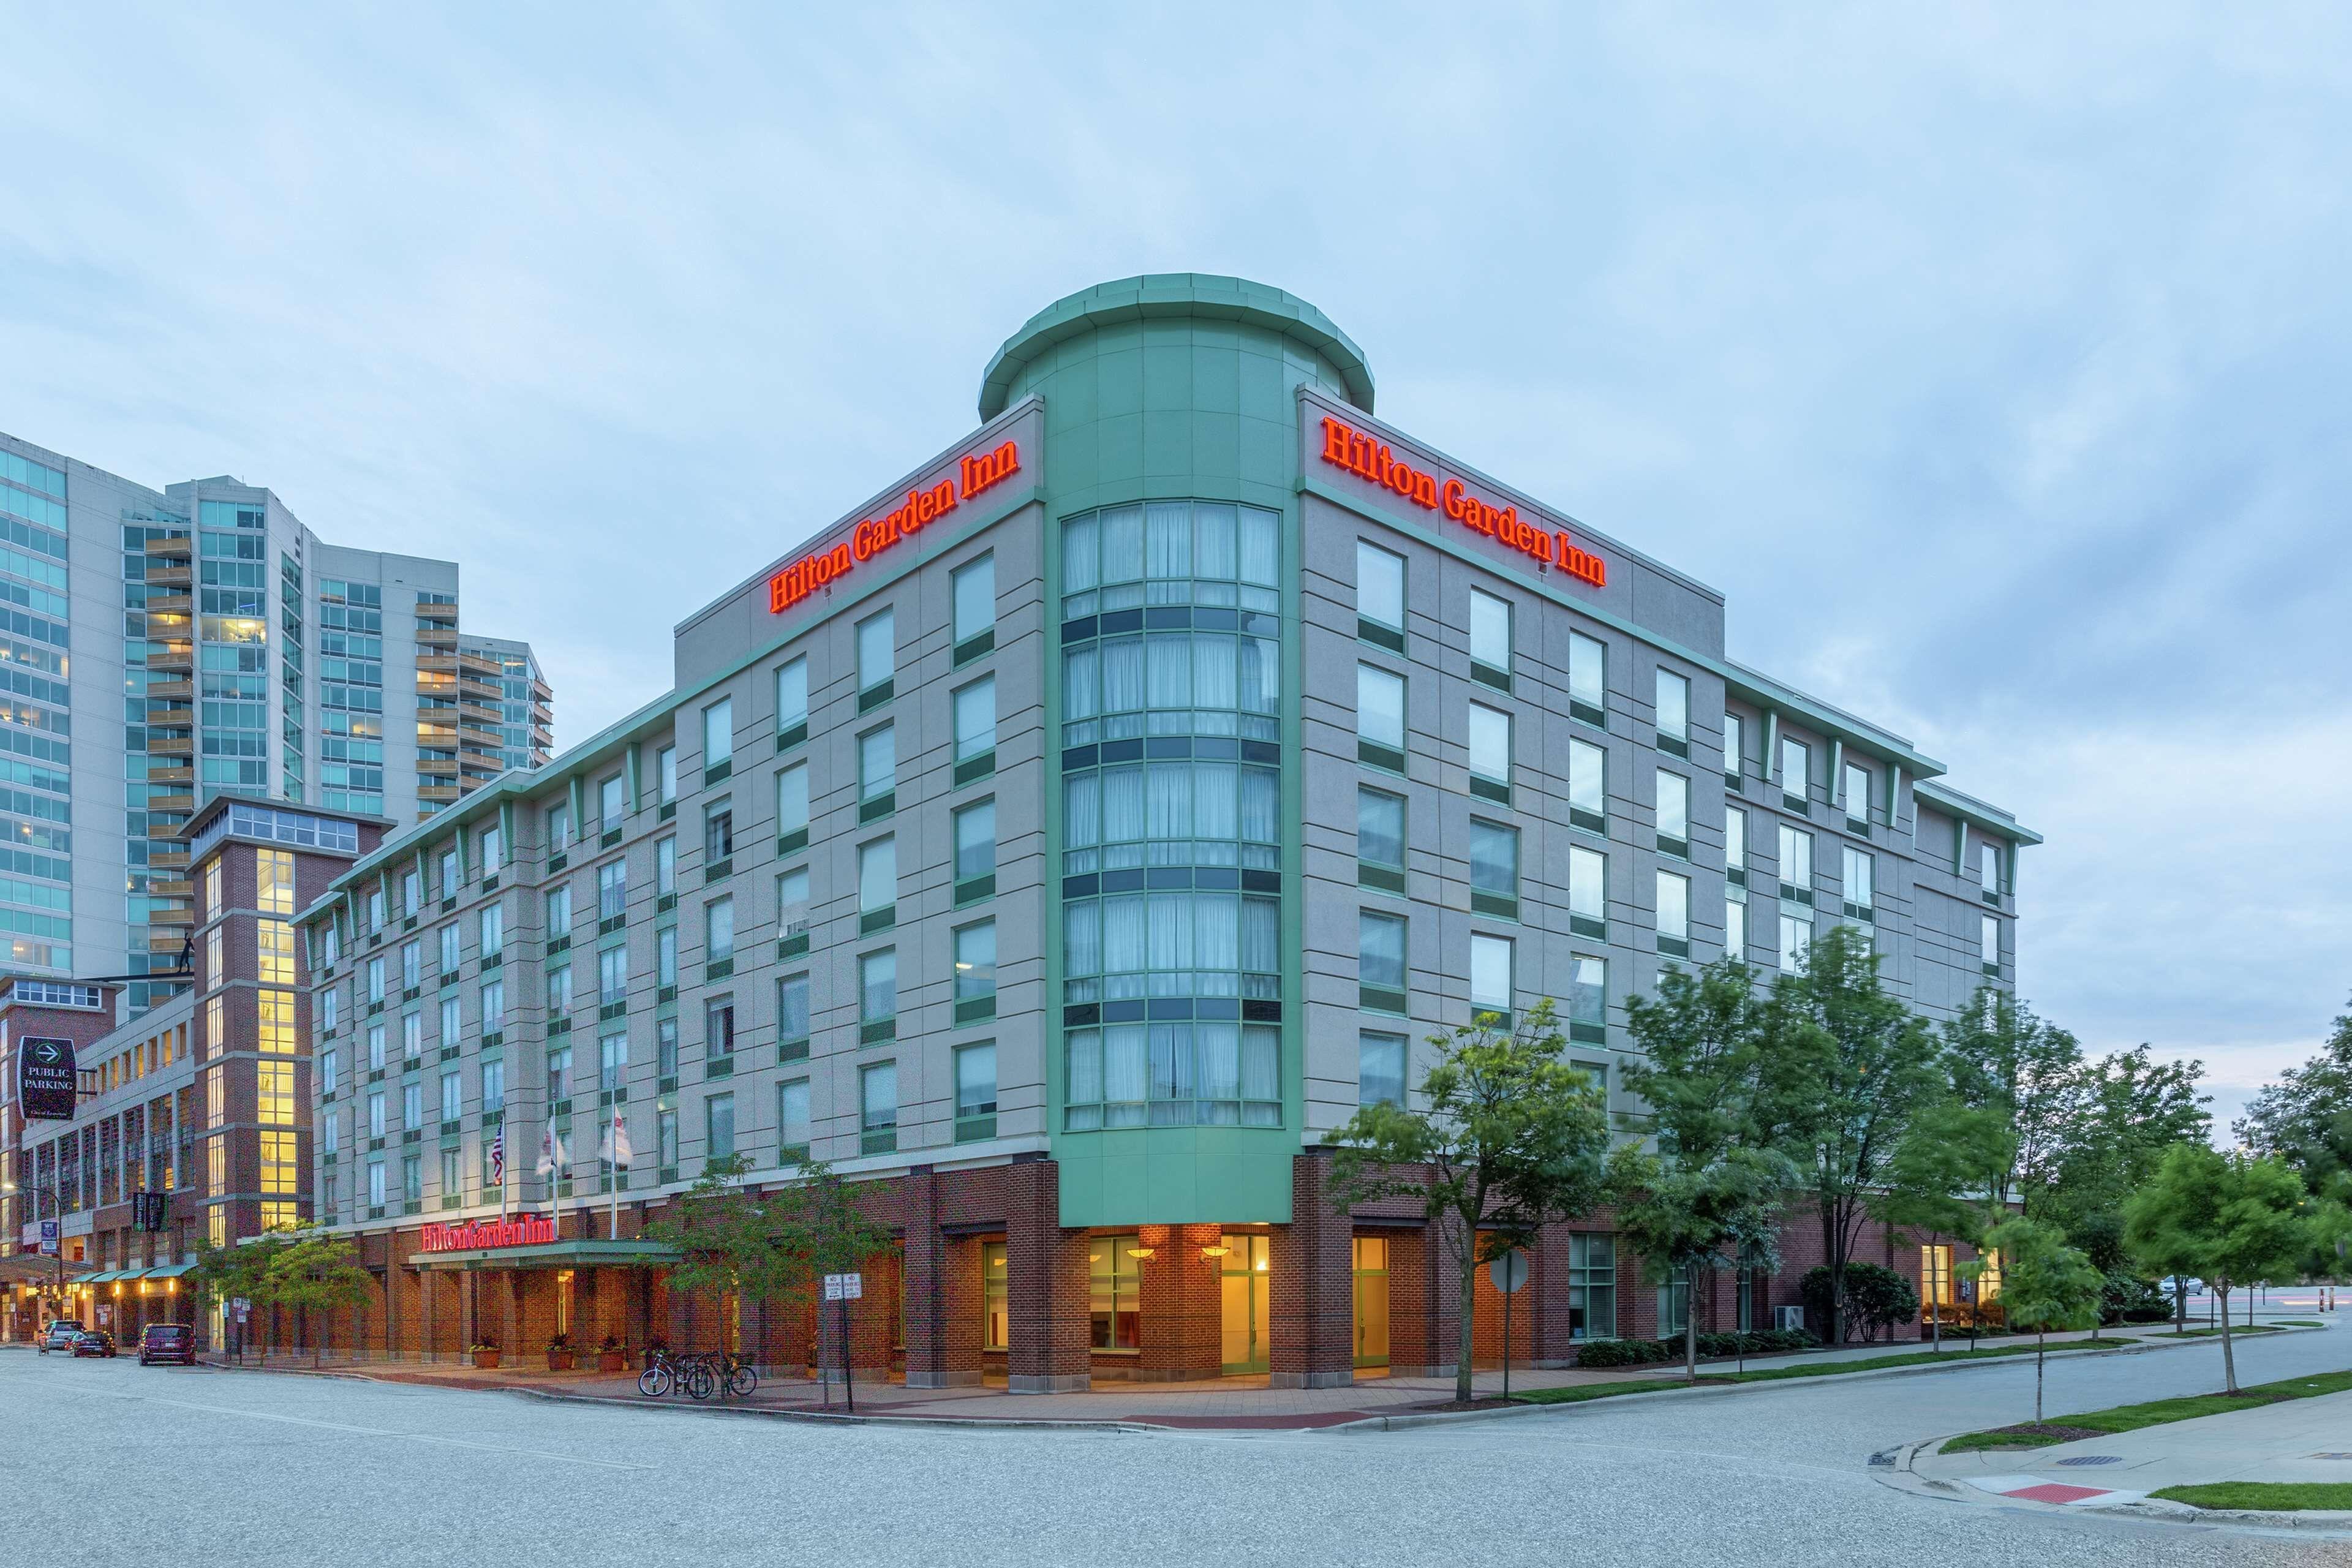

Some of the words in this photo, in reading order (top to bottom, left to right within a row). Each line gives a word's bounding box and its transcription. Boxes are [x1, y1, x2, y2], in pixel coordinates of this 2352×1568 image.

[1323, 417, 1438, 509] Hilton
[1442, 479, 1553, 562] Garden
[1556, 531, 1606, 587] Inn
[770, 543, 852, 614] Hilton
[854, 480, 956, 561] Garden
[960, 441, 1018, 500] Inn
[25, 1080, 72, 1090] PARKING
[29, 1067, 69, 1077] PUBLIC
[421, 1223, 467, 1252] Hilton
[467, 1218, 522, 1249] Garden
[524, 1213, 554, 1245] Inn
